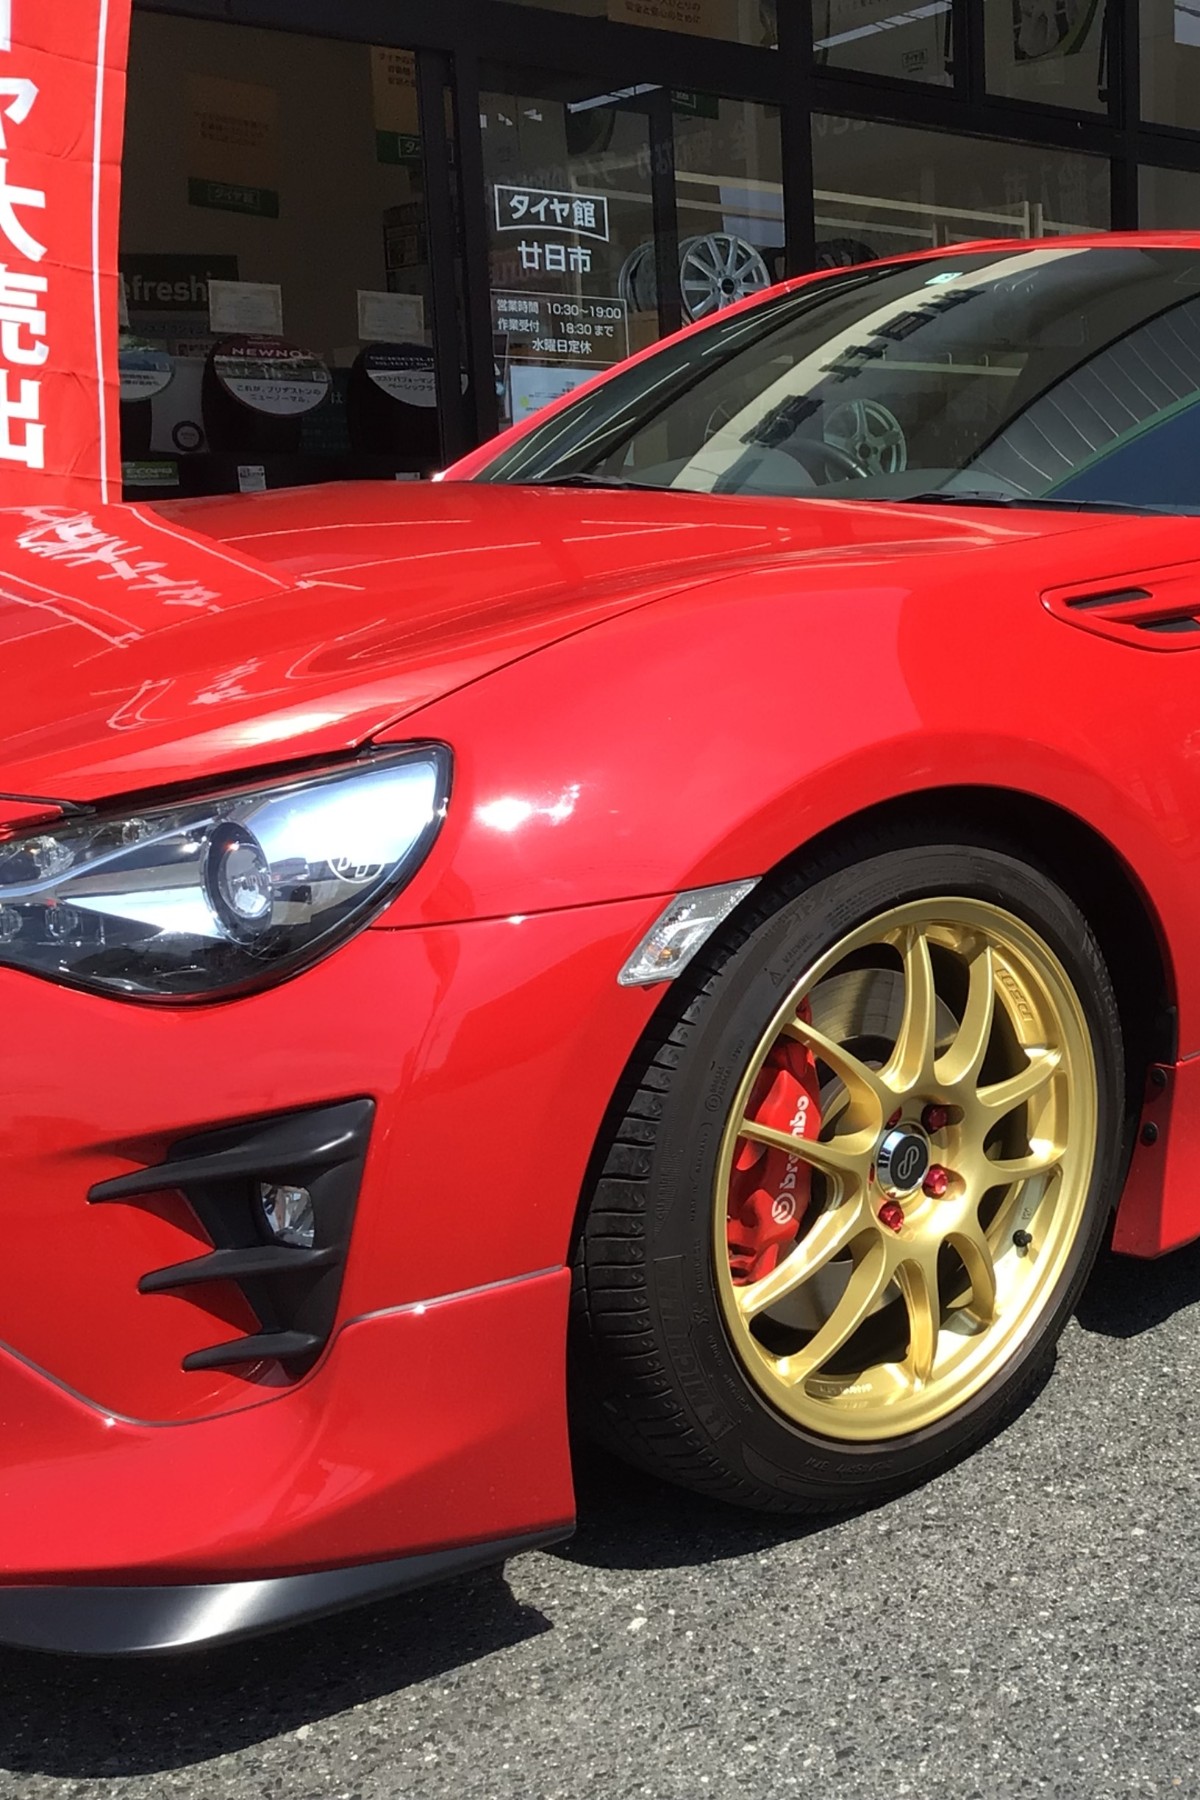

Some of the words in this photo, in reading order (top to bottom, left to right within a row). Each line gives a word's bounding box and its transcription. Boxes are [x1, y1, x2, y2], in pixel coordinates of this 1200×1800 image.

[509, 194, 597, 229] タイヤ館
[517, 240, 592, 274] 廿日市
[497, 299, 540, 315] 営業時間
[497, 318, 540, 333] 作業受付
[559, 321, 592, 336] 18:30
[594, 324, 614, 337] まで
[531, 337, 593, 355] 水曜日定休
